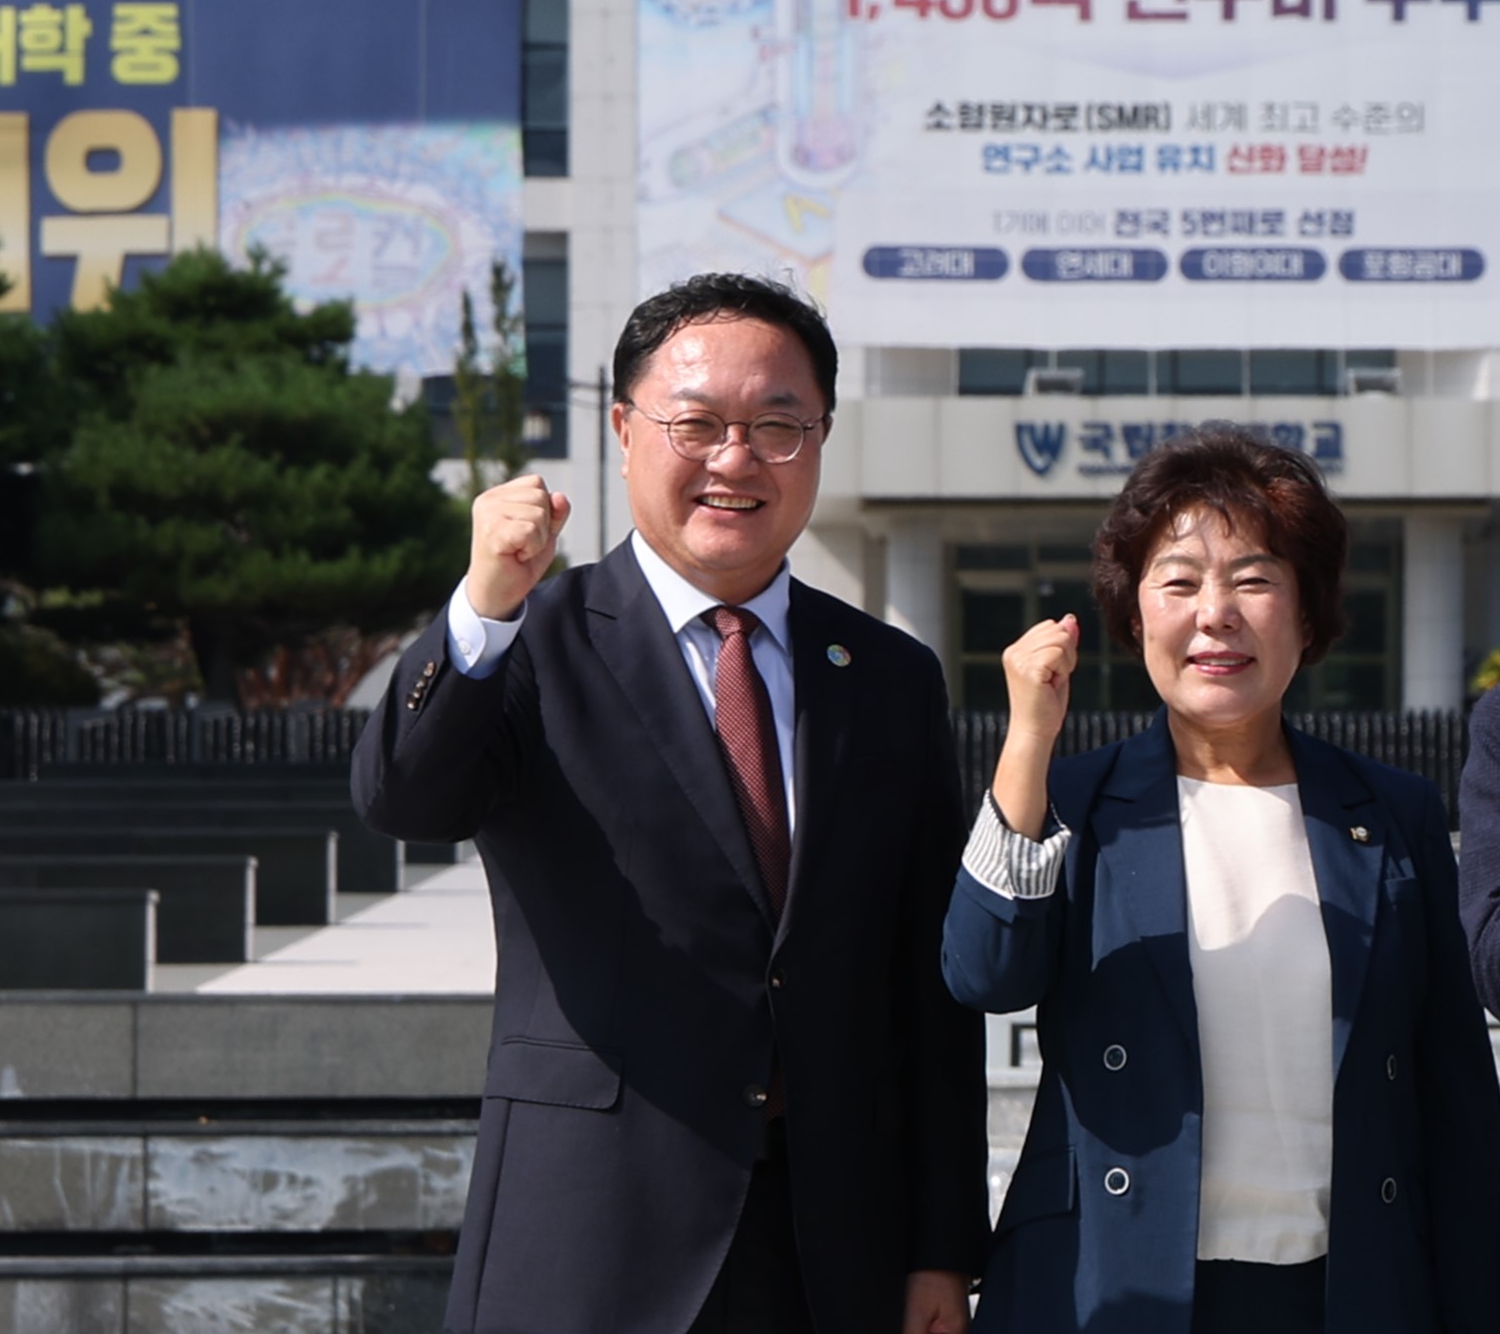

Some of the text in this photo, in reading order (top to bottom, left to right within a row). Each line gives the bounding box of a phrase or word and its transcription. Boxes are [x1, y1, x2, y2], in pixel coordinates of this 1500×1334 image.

[110, 4, 182, 84] 중
[1186, 102, 1248, 133] 세계
[1259, 102, 1319, 133] 최고
[982, 144, 1073, 175] 연구소
[1084, 144, 1145, 175] 사업
[1157, 144, 1216, 175] 유치
